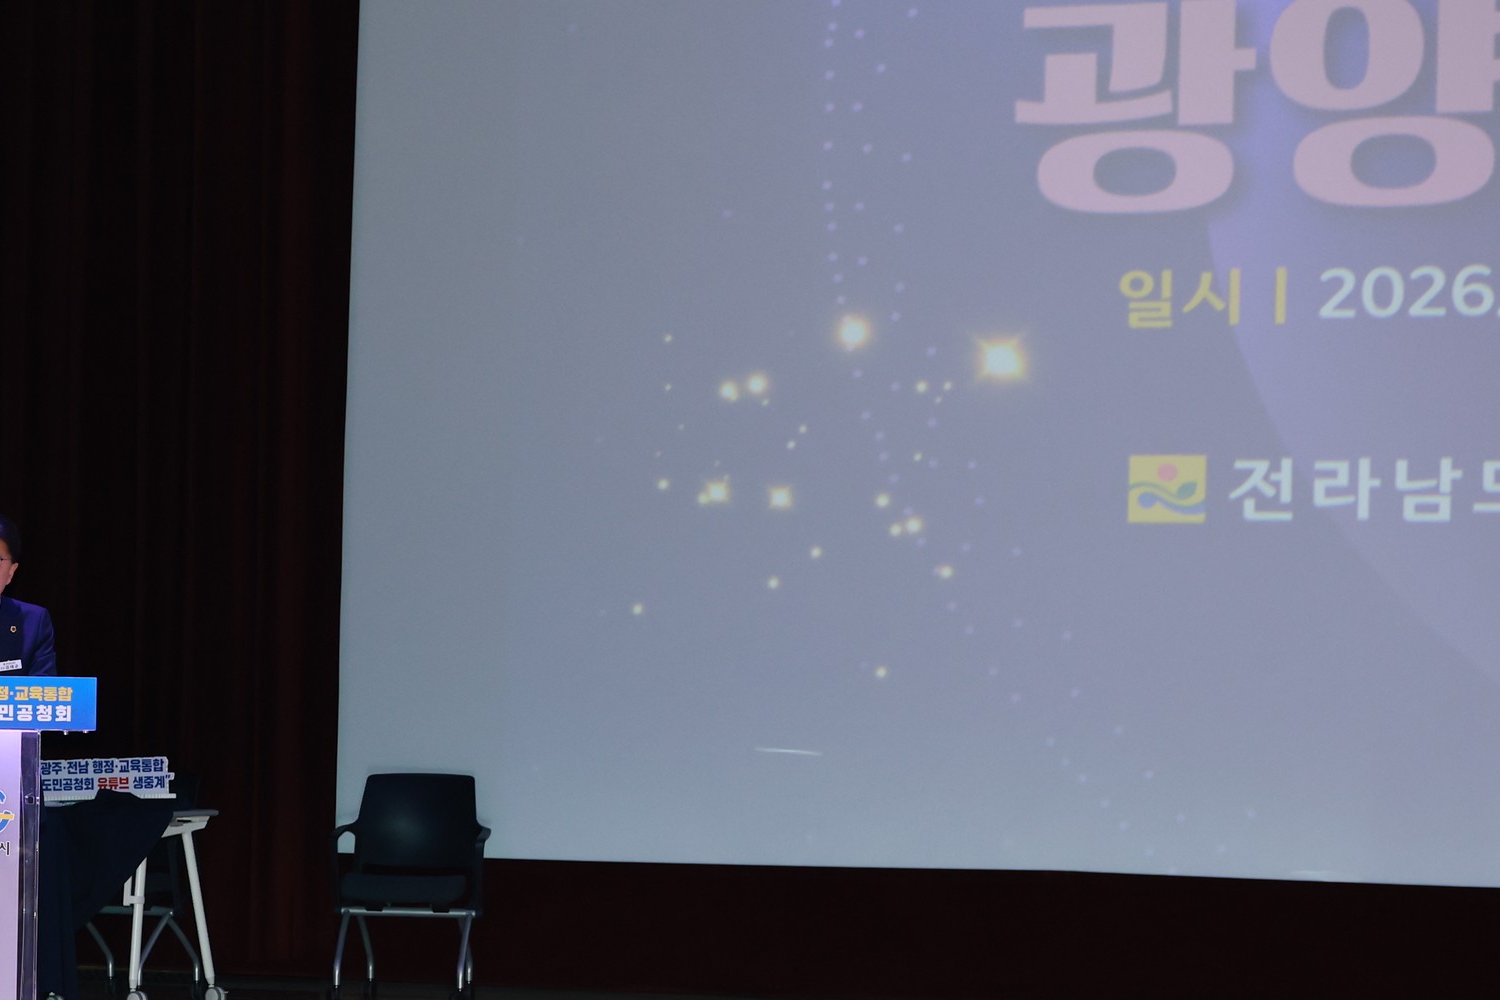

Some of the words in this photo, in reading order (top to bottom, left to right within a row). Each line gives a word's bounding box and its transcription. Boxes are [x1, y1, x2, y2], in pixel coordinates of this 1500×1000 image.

[1119, 268, 1240, 328] 일시
[1318, 264, 1500, 319] 2026
[92, 758, 165, 774] 행정·교육통합
[42, 777, 95, 792] 도민공청회
